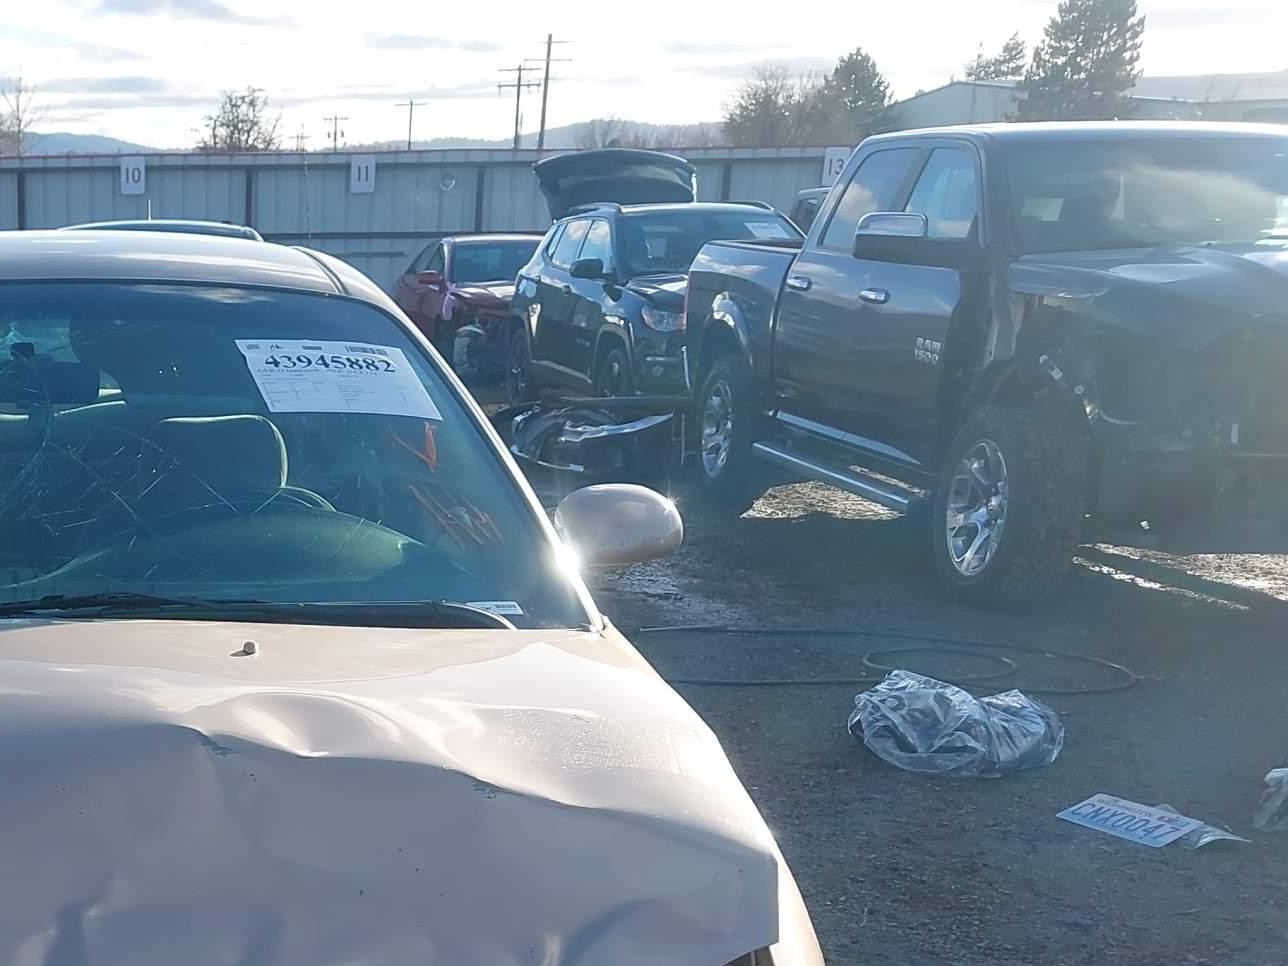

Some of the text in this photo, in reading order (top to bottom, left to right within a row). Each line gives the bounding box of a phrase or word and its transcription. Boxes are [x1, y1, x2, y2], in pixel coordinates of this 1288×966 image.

[125, 166, 142, 184] 10
[357, 165, 369, 182] 11
[265, 354, 396, 373] 43945882
[915, 348, 939, 365] 1500
[1071, 803, 1181, 840] CNX0047
